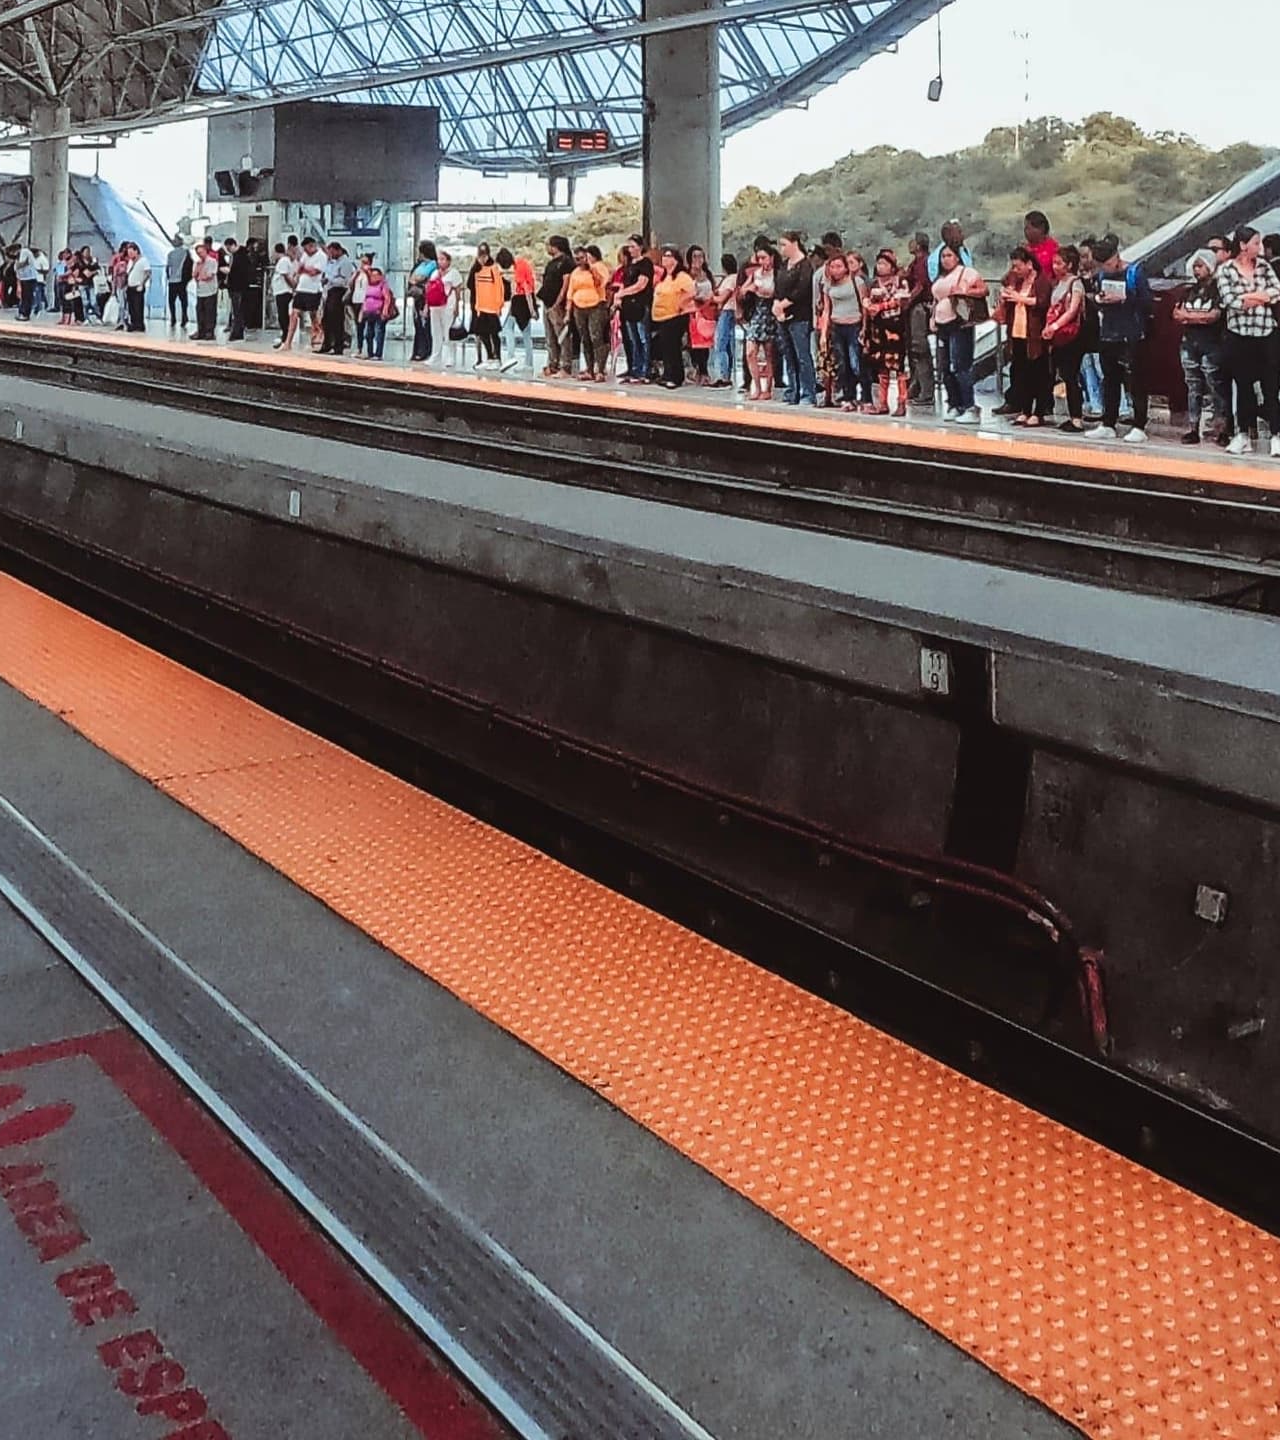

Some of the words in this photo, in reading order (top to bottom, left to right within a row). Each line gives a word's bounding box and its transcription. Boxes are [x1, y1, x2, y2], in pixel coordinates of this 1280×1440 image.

[929, 652, 941, 670] 11
[930, 672, 939, 691] 9
[54, 1263, 139, 1327] DE
